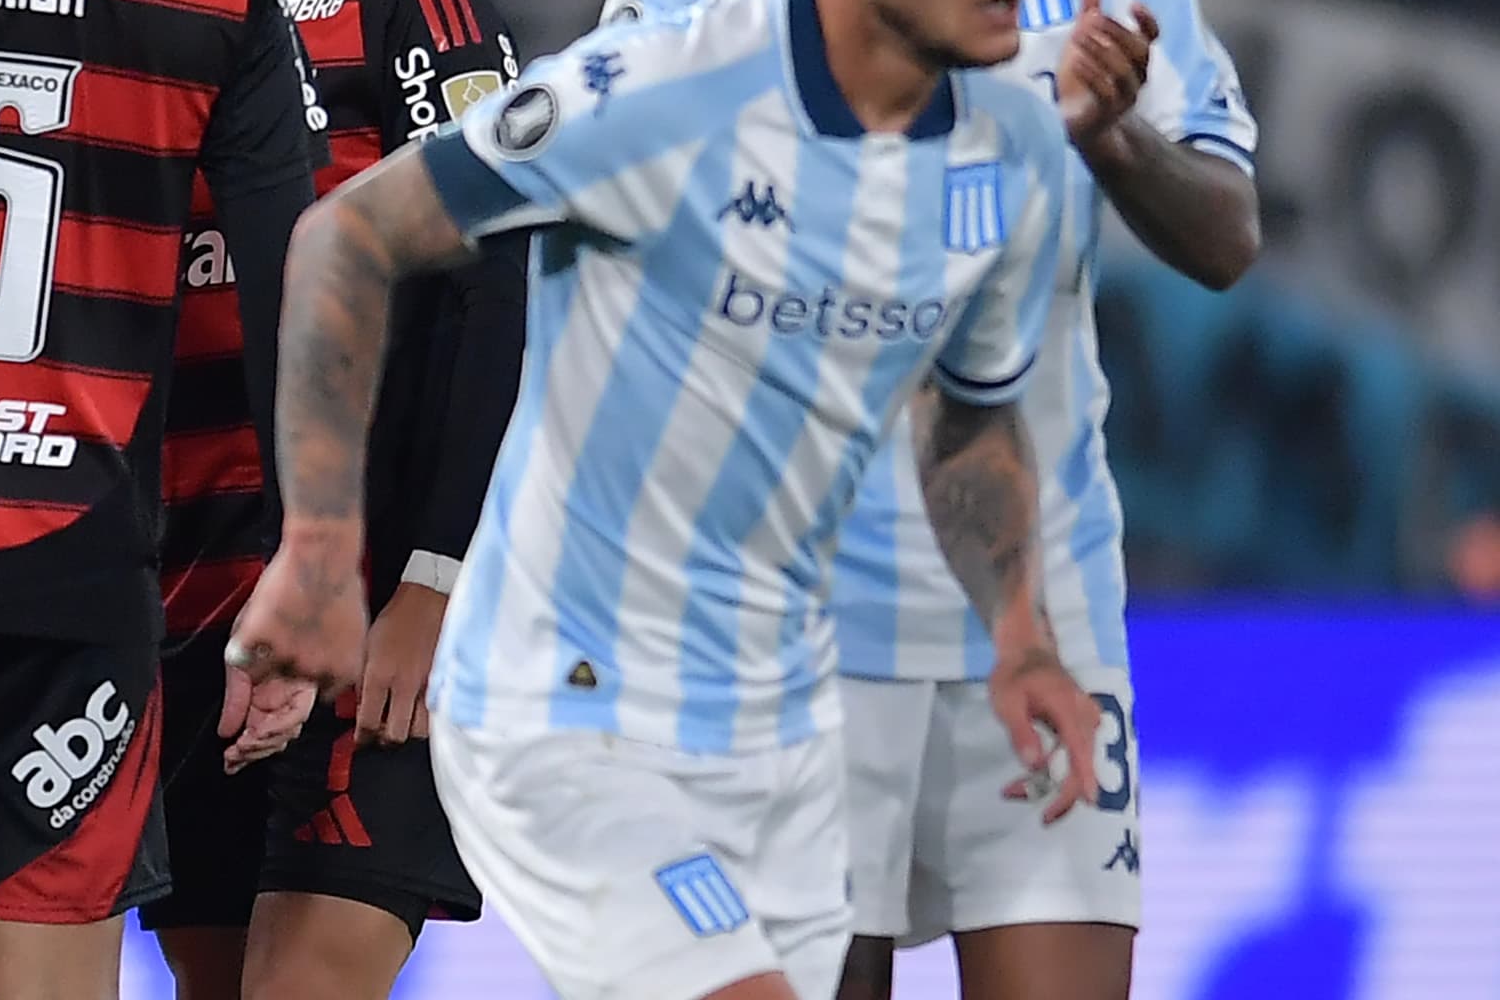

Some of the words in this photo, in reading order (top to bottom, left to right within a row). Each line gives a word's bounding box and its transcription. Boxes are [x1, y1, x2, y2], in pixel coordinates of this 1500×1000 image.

[720, 274, 950, 340] betsso
[11, 679, 130, 809] abc
[49, 804, 76, 829] da
